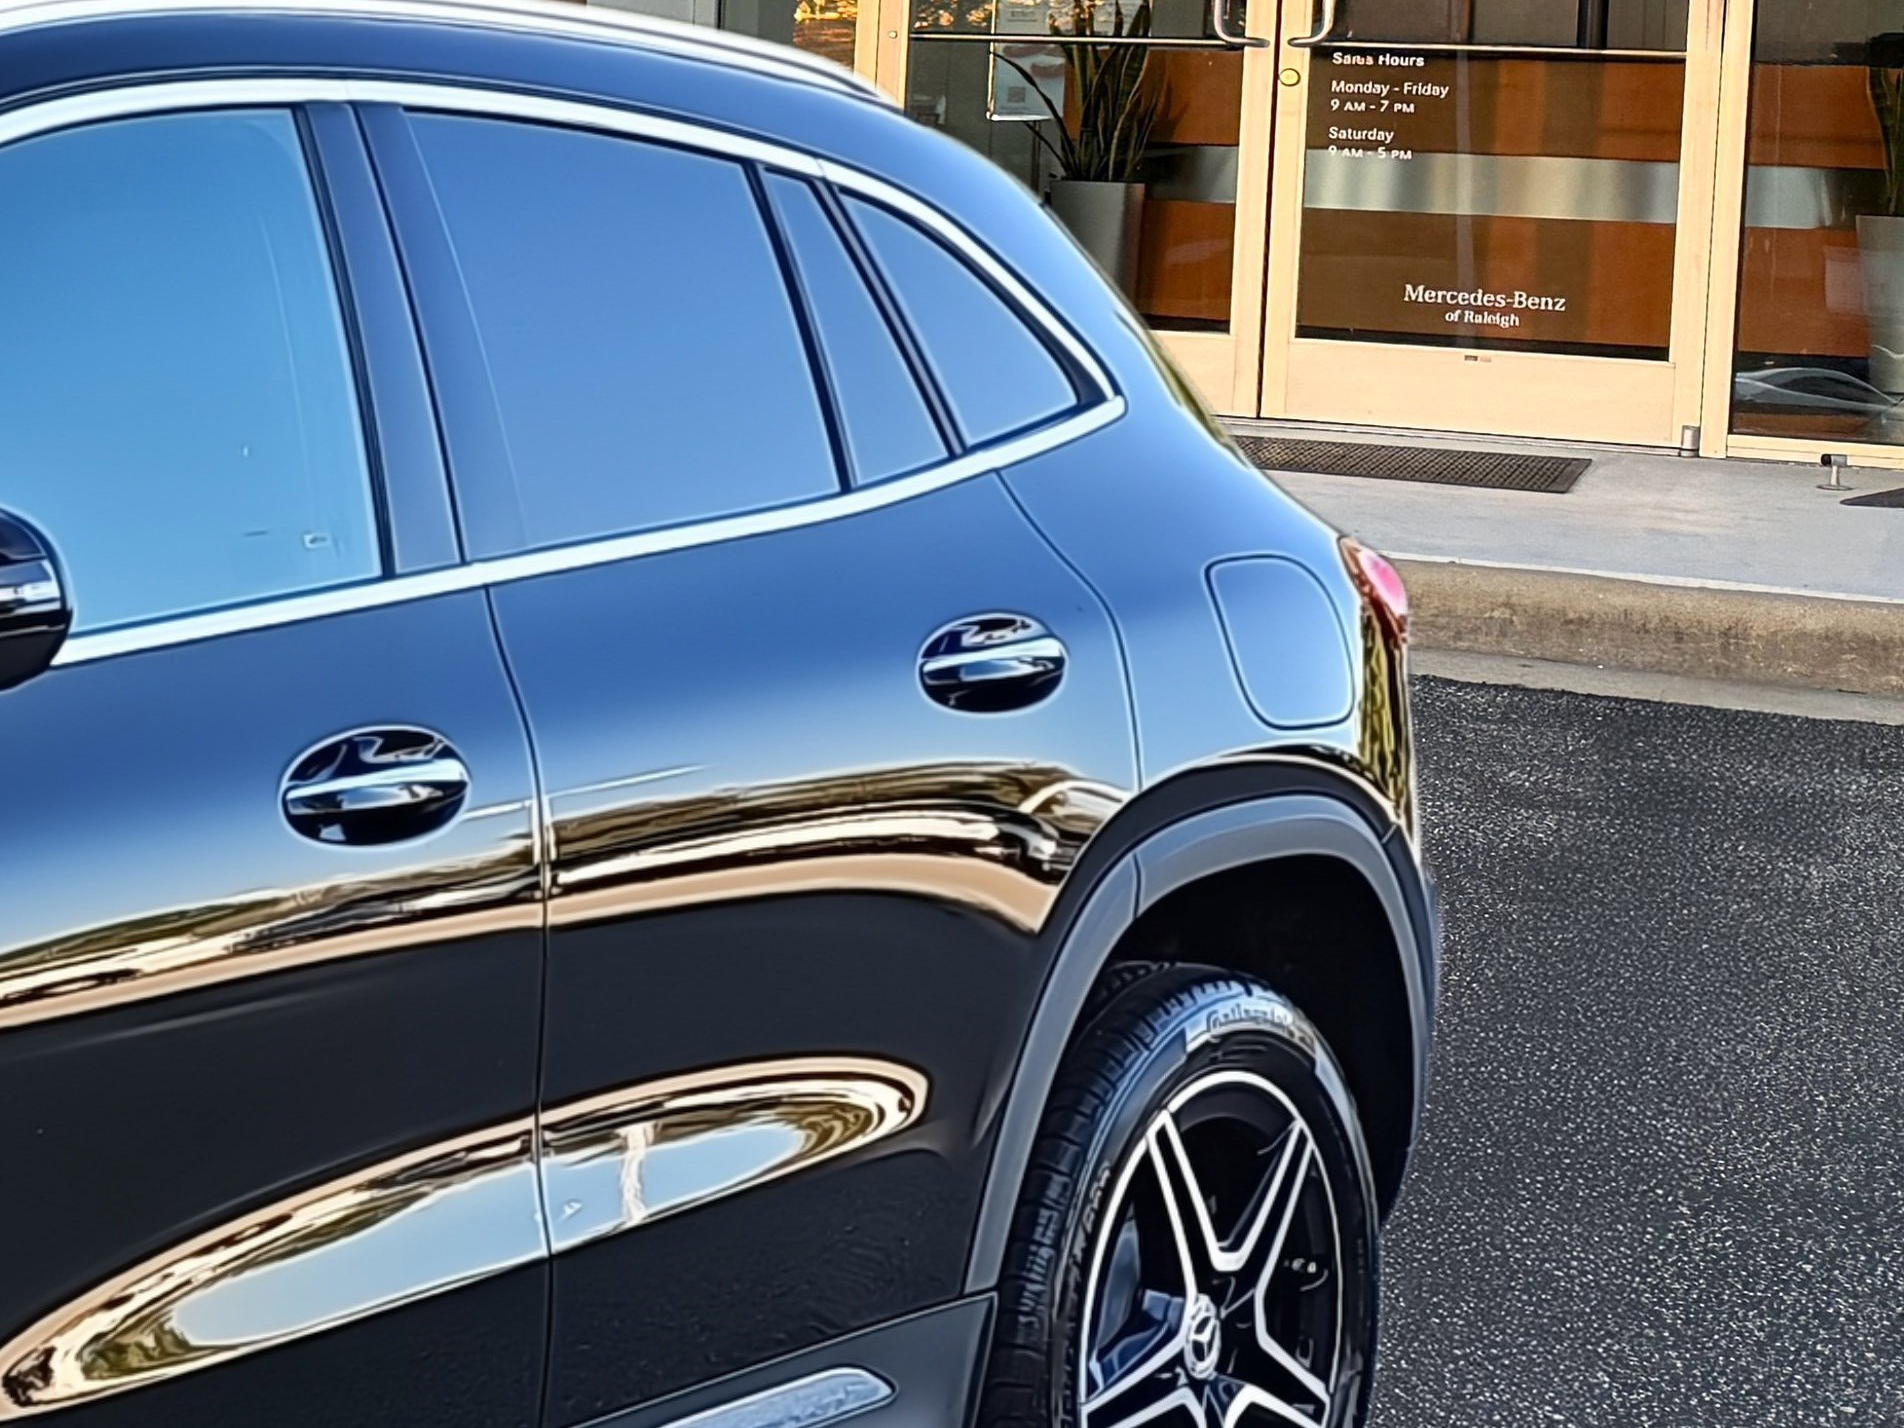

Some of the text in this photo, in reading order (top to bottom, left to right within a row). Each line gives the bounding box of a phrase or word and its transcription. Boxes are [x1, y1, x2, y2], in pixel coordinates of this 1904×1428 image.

[1378, 53, 1425, 67] Hours
[1331, 80, 1390, 97] Monday
[1403, 82, 1449, 98] Friday
[1330, 99, 1340, 111] 9
[1344, 102, 1366, 112] AM
[1380, 100, 1389, 112] 7
[1393, 103, 1414, 113] PM
[1328, 126, 1394, 144] Saturday
[1328, 145, 1337, 157] 9
[1342, 148, 1363, 158] AM
[1377, 146, 1387, 159] 5
[1391, 149, 1412, 160] PM
[1403, 284, 1566, 311] Mercedes-Benz
[1445, 310, 1461, 322] of
